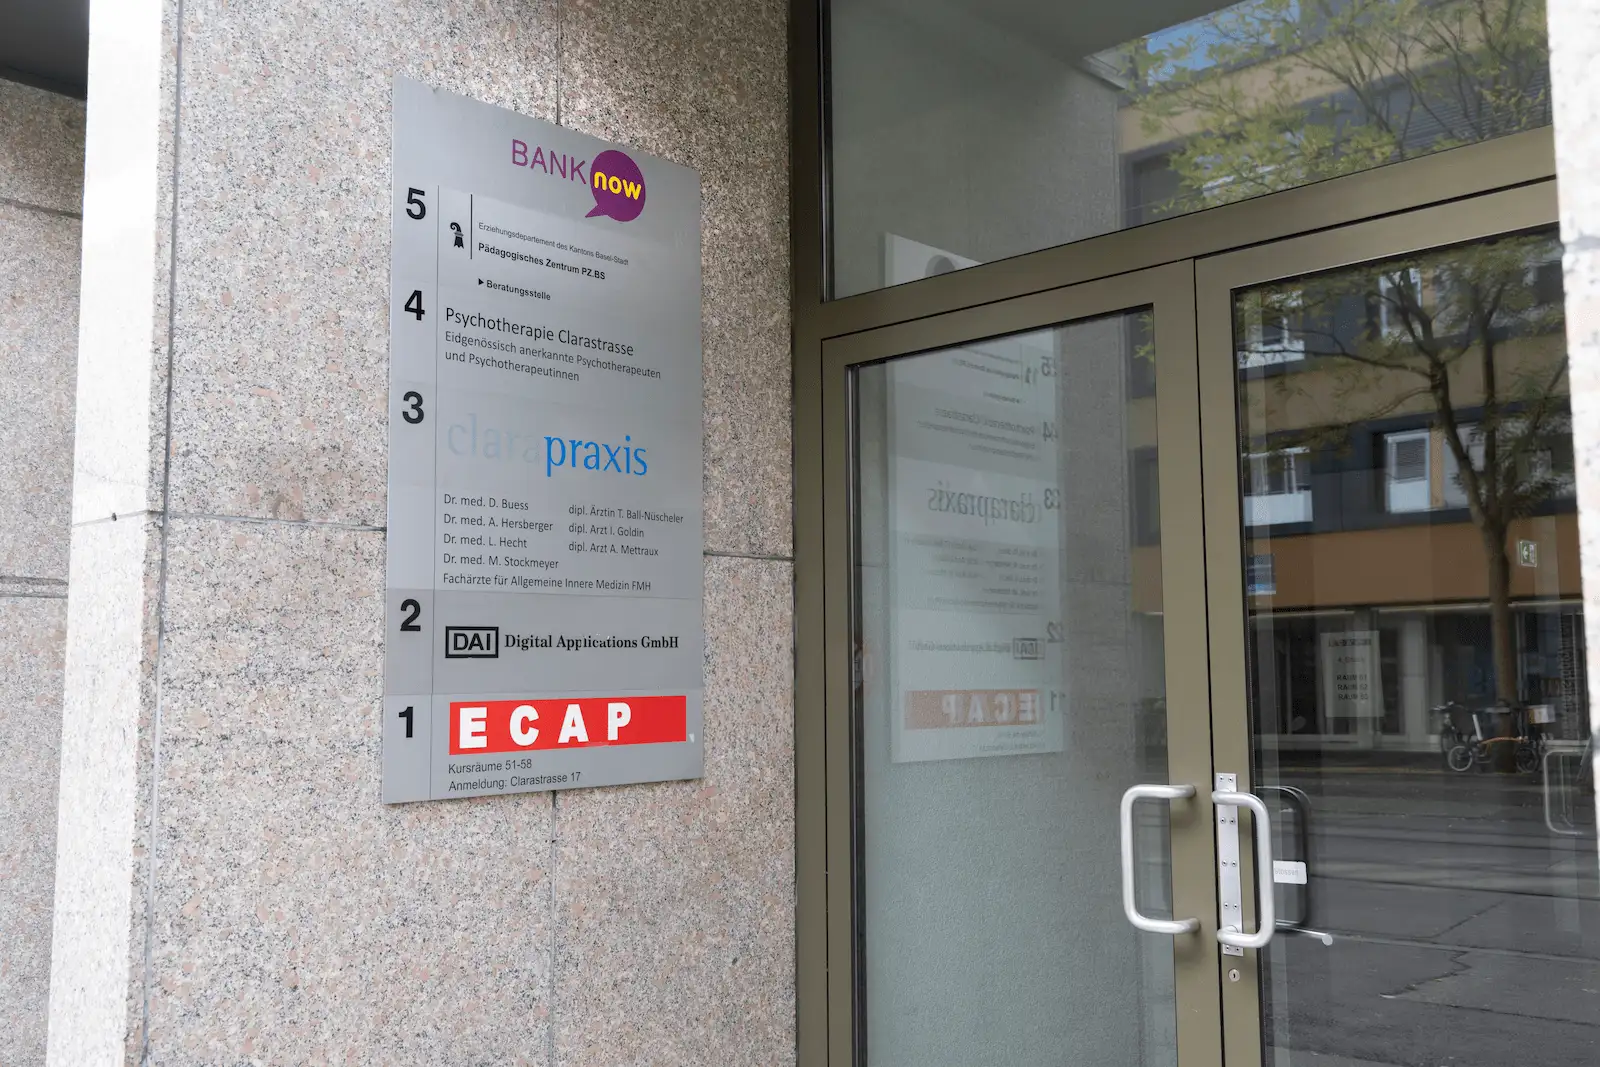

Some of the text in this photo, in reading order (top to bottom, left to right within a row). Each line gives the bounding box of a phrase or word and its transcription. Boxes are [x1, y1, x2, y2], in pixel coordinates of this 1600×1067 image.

[512, 139, 643, 200] BANK now
[406, 187, 426, 220] 5
[478, 222, 629, 266] Erziehungsdepartement des Kantons Basel-Stadt
[478, 242, 606, 280] Pädagogisches Zentrum PZ.BS
[486, 279, 551, 301] Beratungsstelle
[404, 289, 425, 321] 4
[446, 307, 634, 356] Psychotherapie Clarastrasse
[445, 331, 661, 380] Eidgenössisch anerkannte Psychotherapeuten
[445, 351, 580, 382] und Psychotherapeutinnen
[402, 391, 424, 424] 3
[444, 493, 529, 510] Dr. med. D. Buess
[568, 504, 684, 524] dipl. Ärztin T. Ball-Nüscheler
[444, 513, 553, 532] Dr. med. A. Hersberger
[568, 523, 644, 538] dipl. Arzt I. Goldin
[443, 533, 528, 549] Dr. med. L. Hecht
[568, 541, 659, 556] dipl. Arzt A. Mettraux
[443, 552, 559, 571] Dr. med. M. Stockmeyer
[443, 572, 651, 591] Fachärzte für Allgemeine Innere Medizin FMH
[400, 598, 421, 632] 2
[452, 633, 679, 651] DAI Digital Applications GmbH
[398, 706, 414, 738] 1
[459, 702, 632, 749] ECAP
[448, 758, 532, 774] Kursräume 51-58
[448, 771, 581, 792] Anmeldung: Clarastrasse 17
